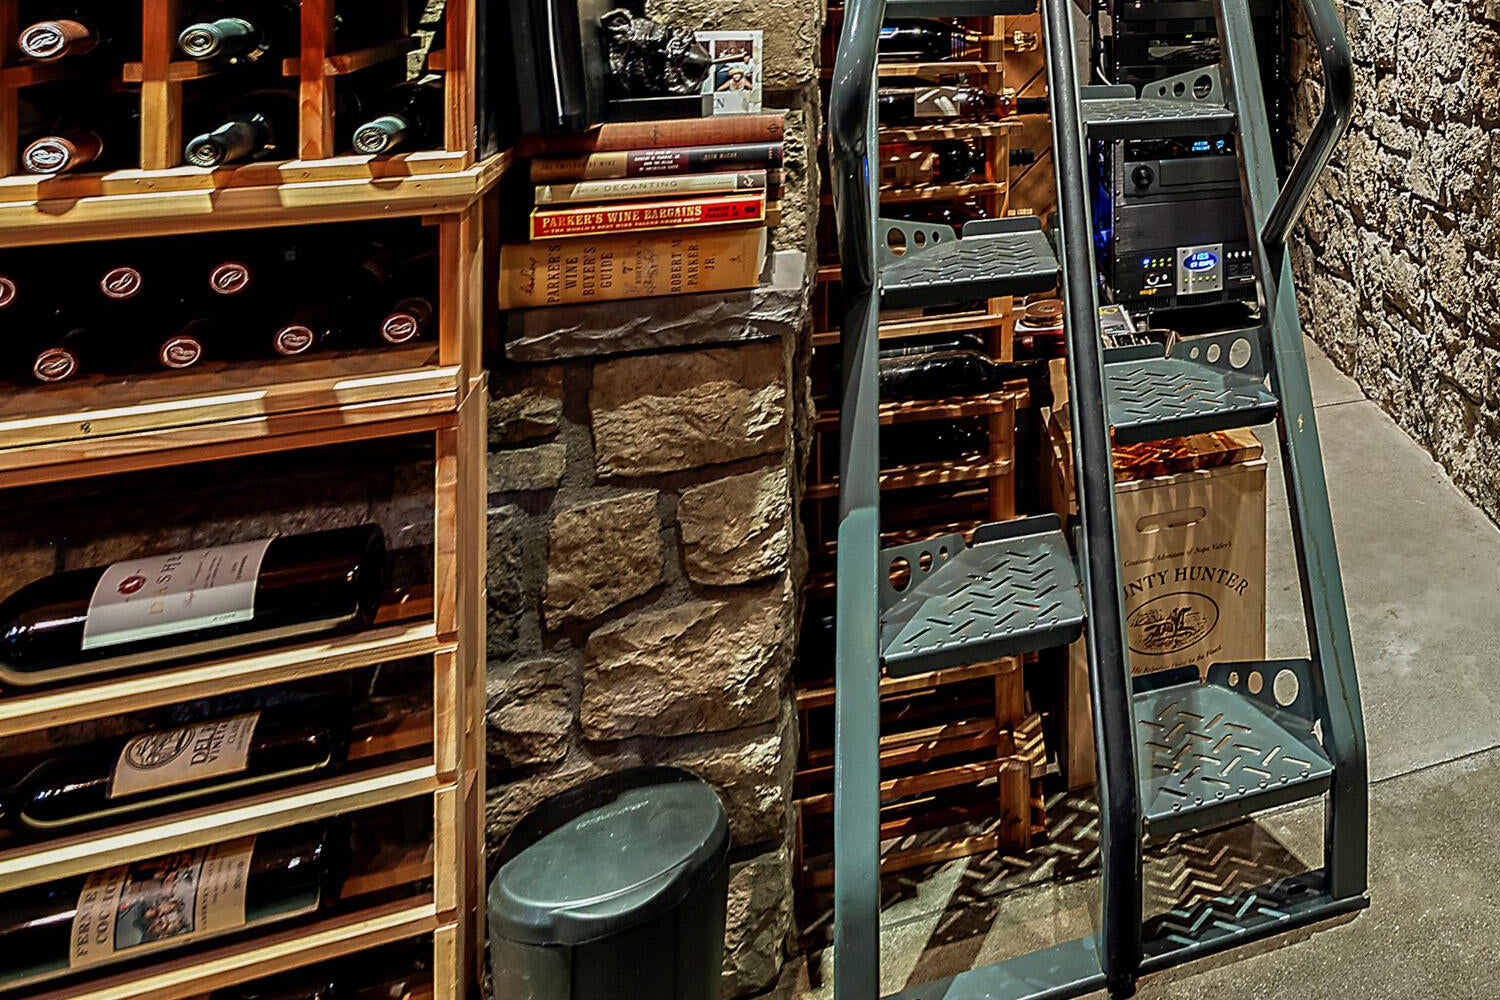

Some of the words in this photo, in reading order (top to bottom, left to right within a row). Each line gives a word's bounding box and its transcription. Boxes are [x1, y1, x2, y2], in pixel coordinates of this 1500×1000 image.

[603, 181, 679, 192] DECANTING
[542, 213, 603, 229] PARKER'S
[607, 210, 640, 223] WINE
[644, 205, 702, 219] BARGAINS
[547, 244, 561, 304] PARKER'S
[565, 255, 578, 289] WINE
[583, 247, 596, 296] BUYER'S
[601, 252, 613, 289] GUIDE
[672, 253, 682, 294] ROBERT
[1175, 566, 1249, 596] HUNTER
